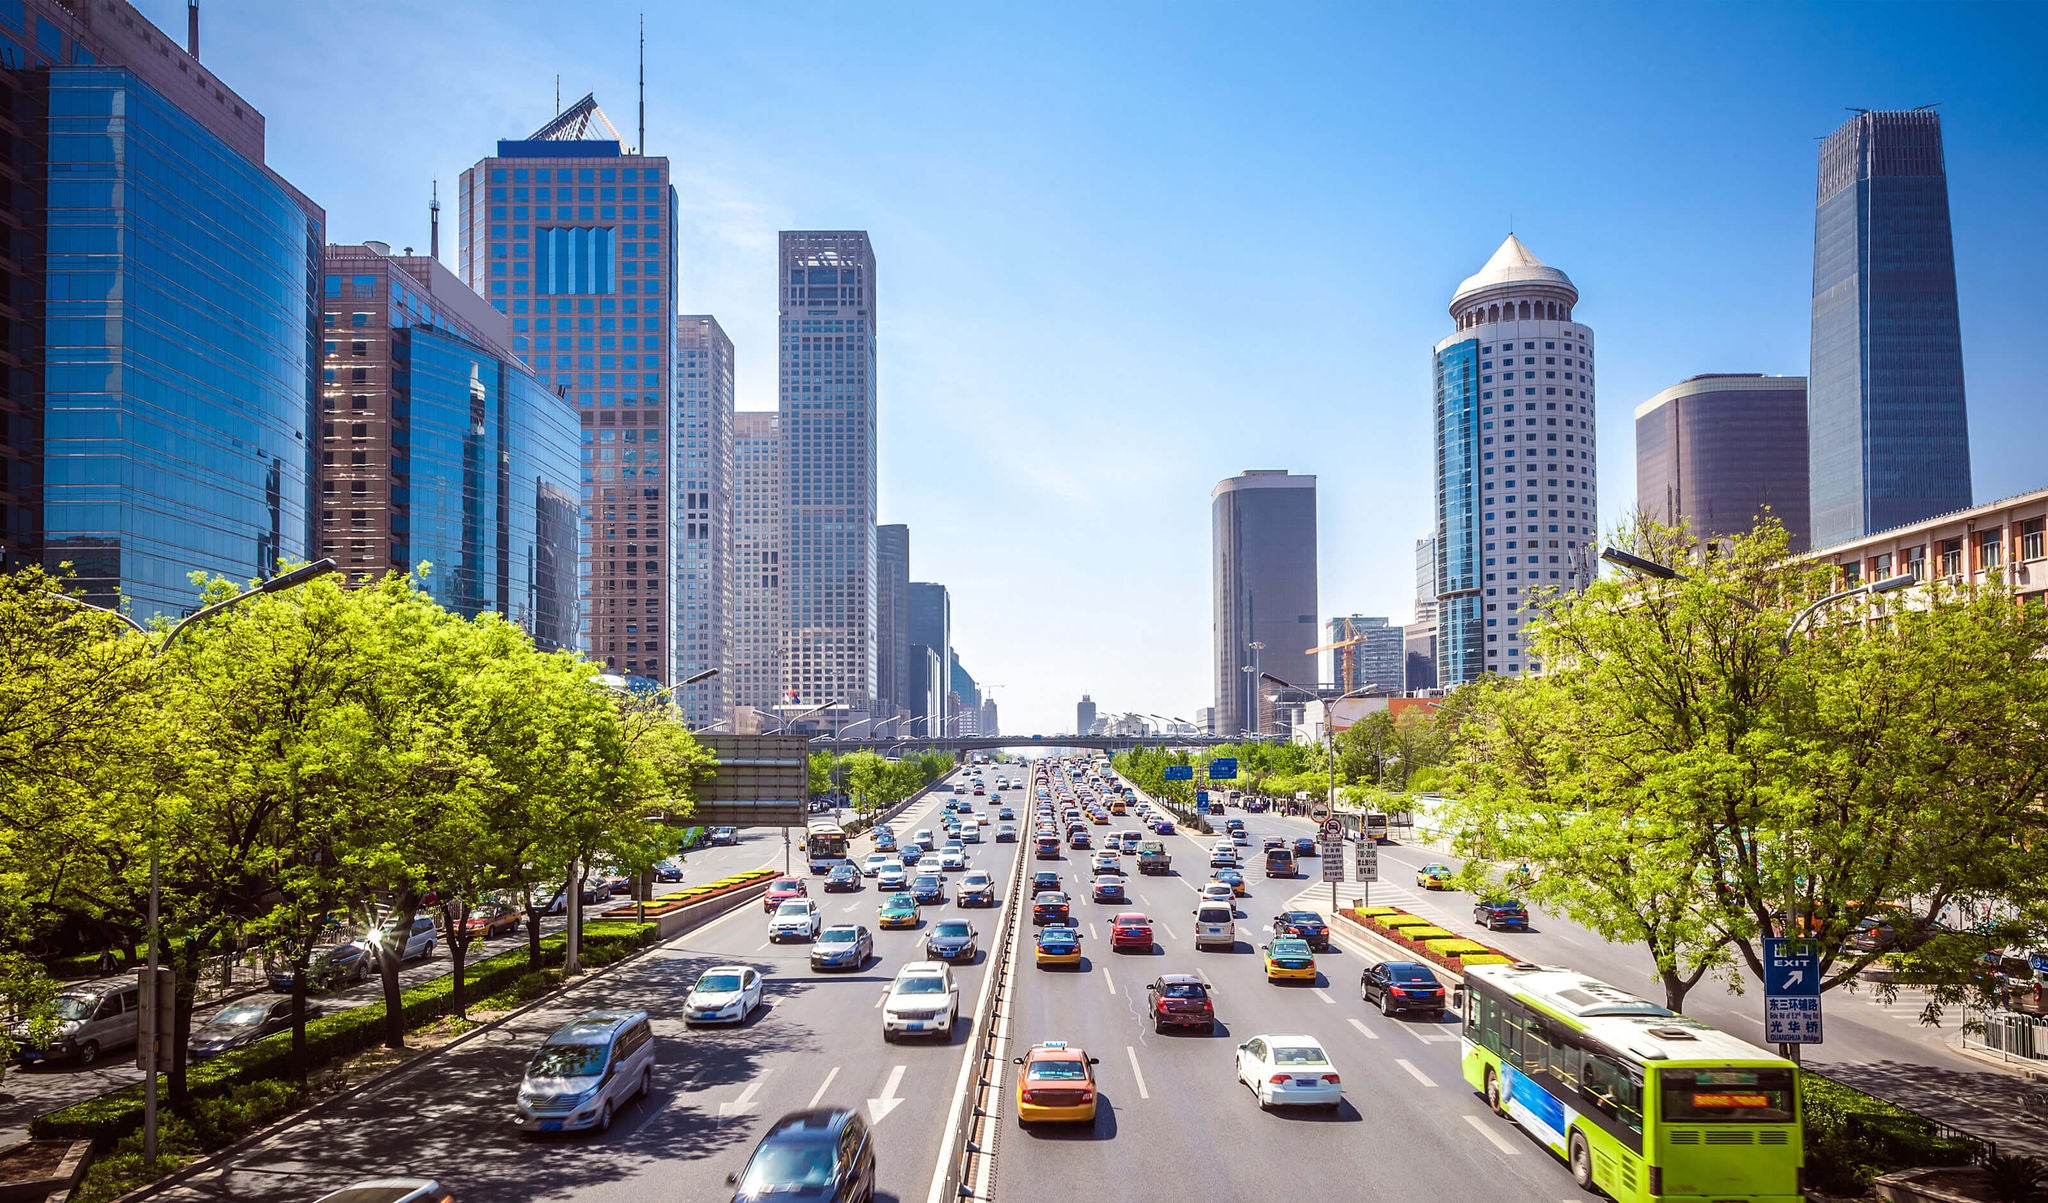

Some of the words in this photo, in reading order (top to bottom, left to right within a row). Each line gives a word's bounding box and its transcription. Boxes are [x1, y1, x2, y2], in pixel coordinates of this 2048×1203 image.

[1769, 998, 1818, 1011] 东三环辅路
[1770, 1020, 1818, 1033] 光华桥
[1803, 1034, 1819, 1042] Bridge
